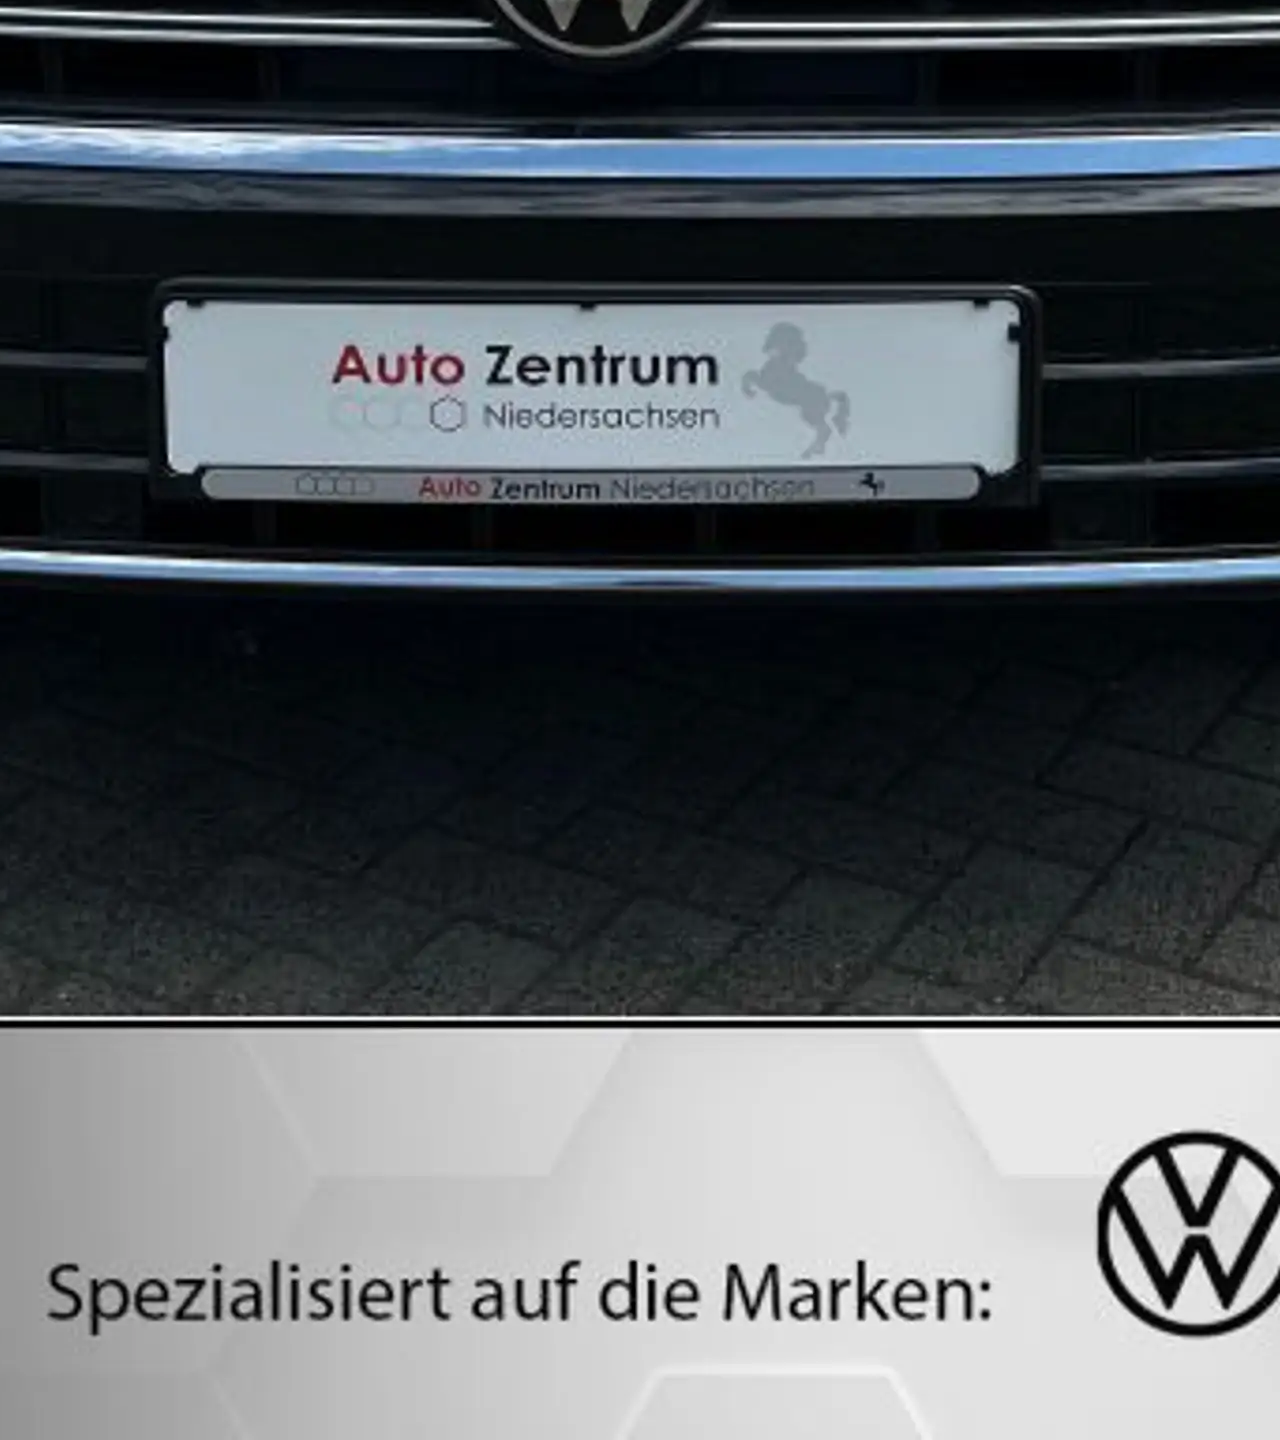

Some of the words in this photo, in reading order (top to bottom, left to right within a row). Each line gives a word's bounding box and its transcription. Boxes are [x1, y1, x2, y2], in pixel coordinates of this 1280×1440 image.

[332, 344, 466, 385] Auto
[485, 344, 718, 386] Zentrum
[483, 400, 721, 431] Niedersachsen
[418, 476, 482, 500] Auto
[489, 477, 600, 501] Zentrum
[609, 477, 816, 501] Niedersachsen
